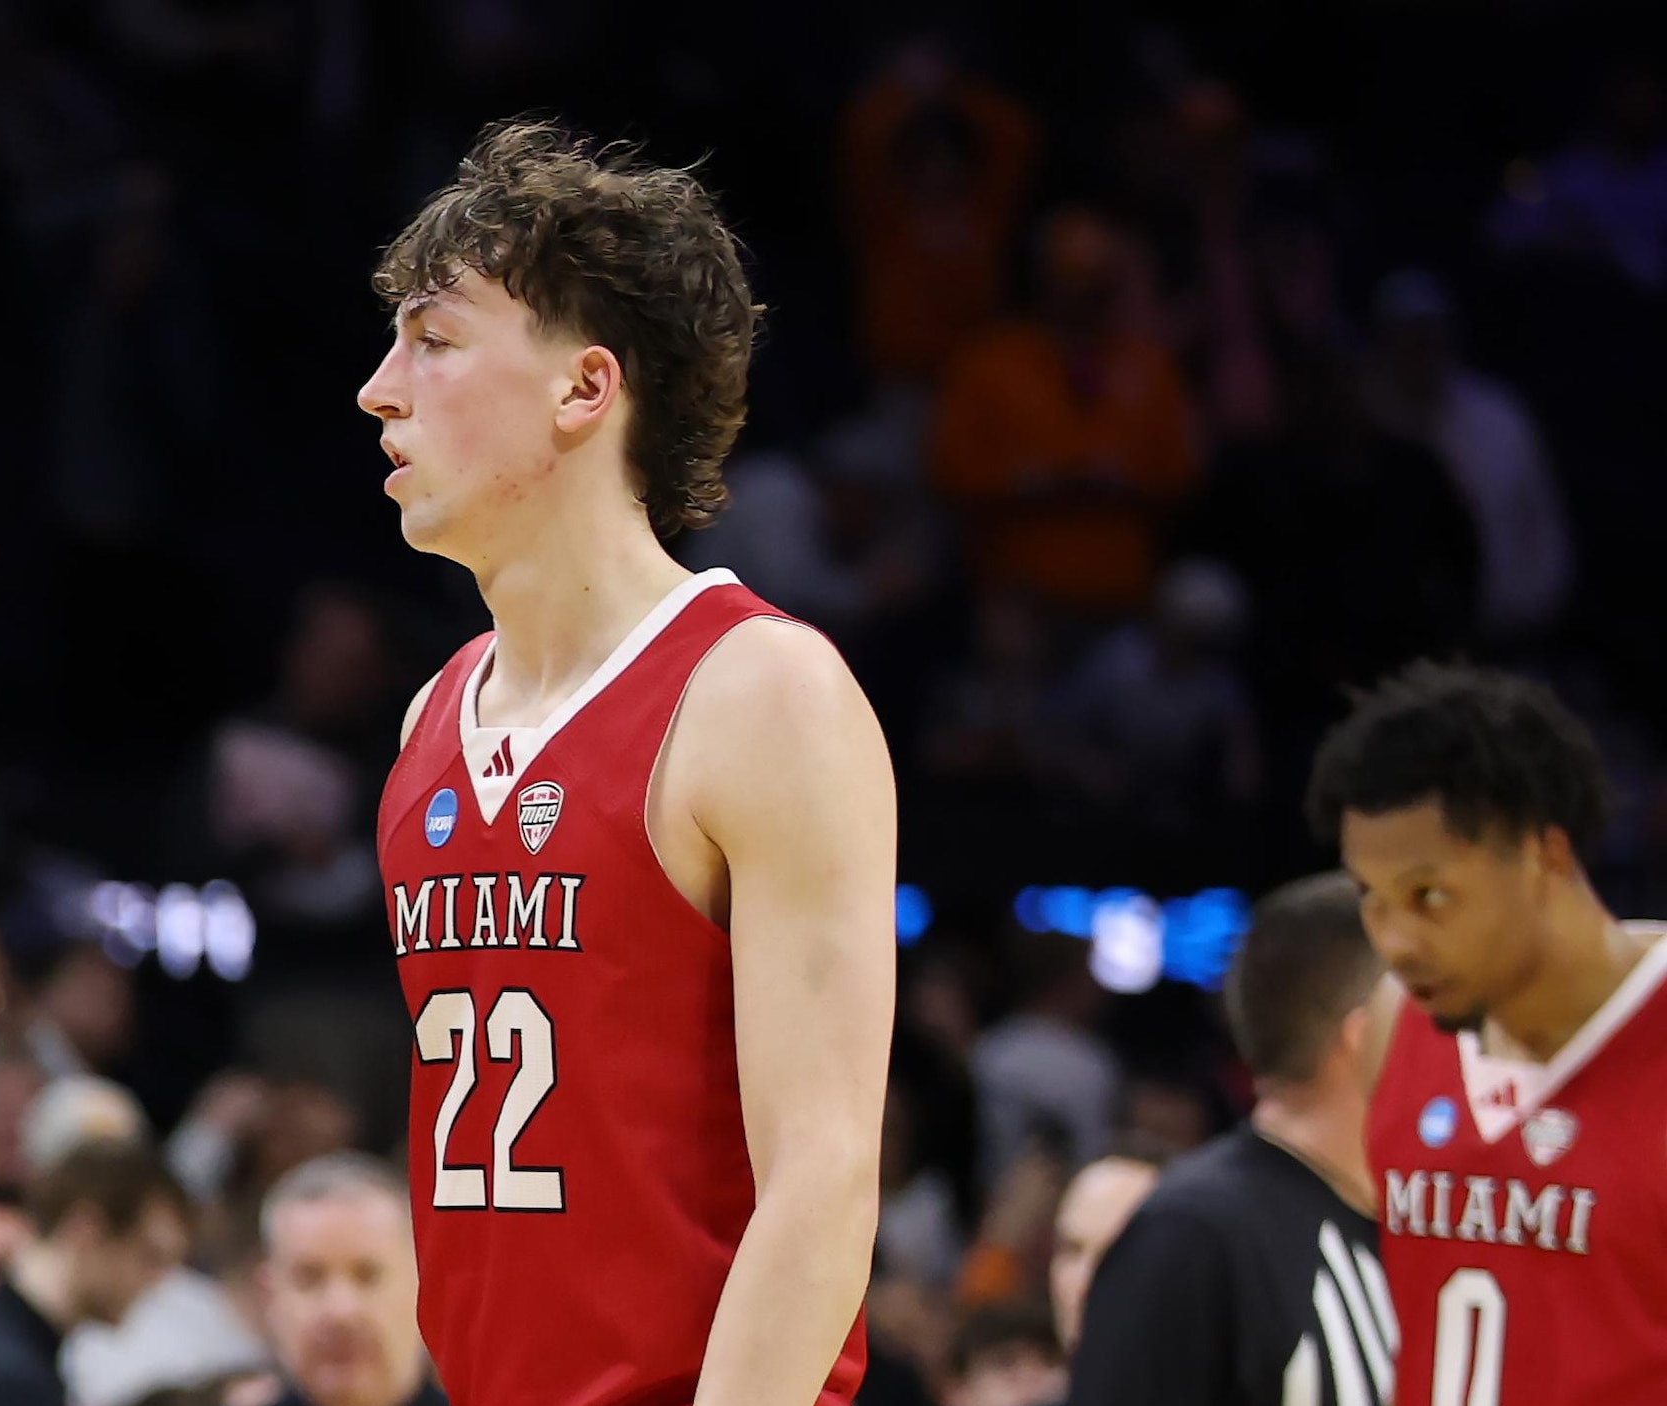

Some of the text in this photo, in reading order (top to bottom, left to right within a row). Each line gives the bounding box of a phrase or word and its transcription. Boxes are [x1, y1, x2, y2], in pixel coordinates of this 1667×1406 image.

[521, 805, 558, 823] MAC
[393, 872, 586, 956] MIAMI
[414, 987, 567, 1212] 22
[1385, 1168, 1596, 1254] MIAMI
